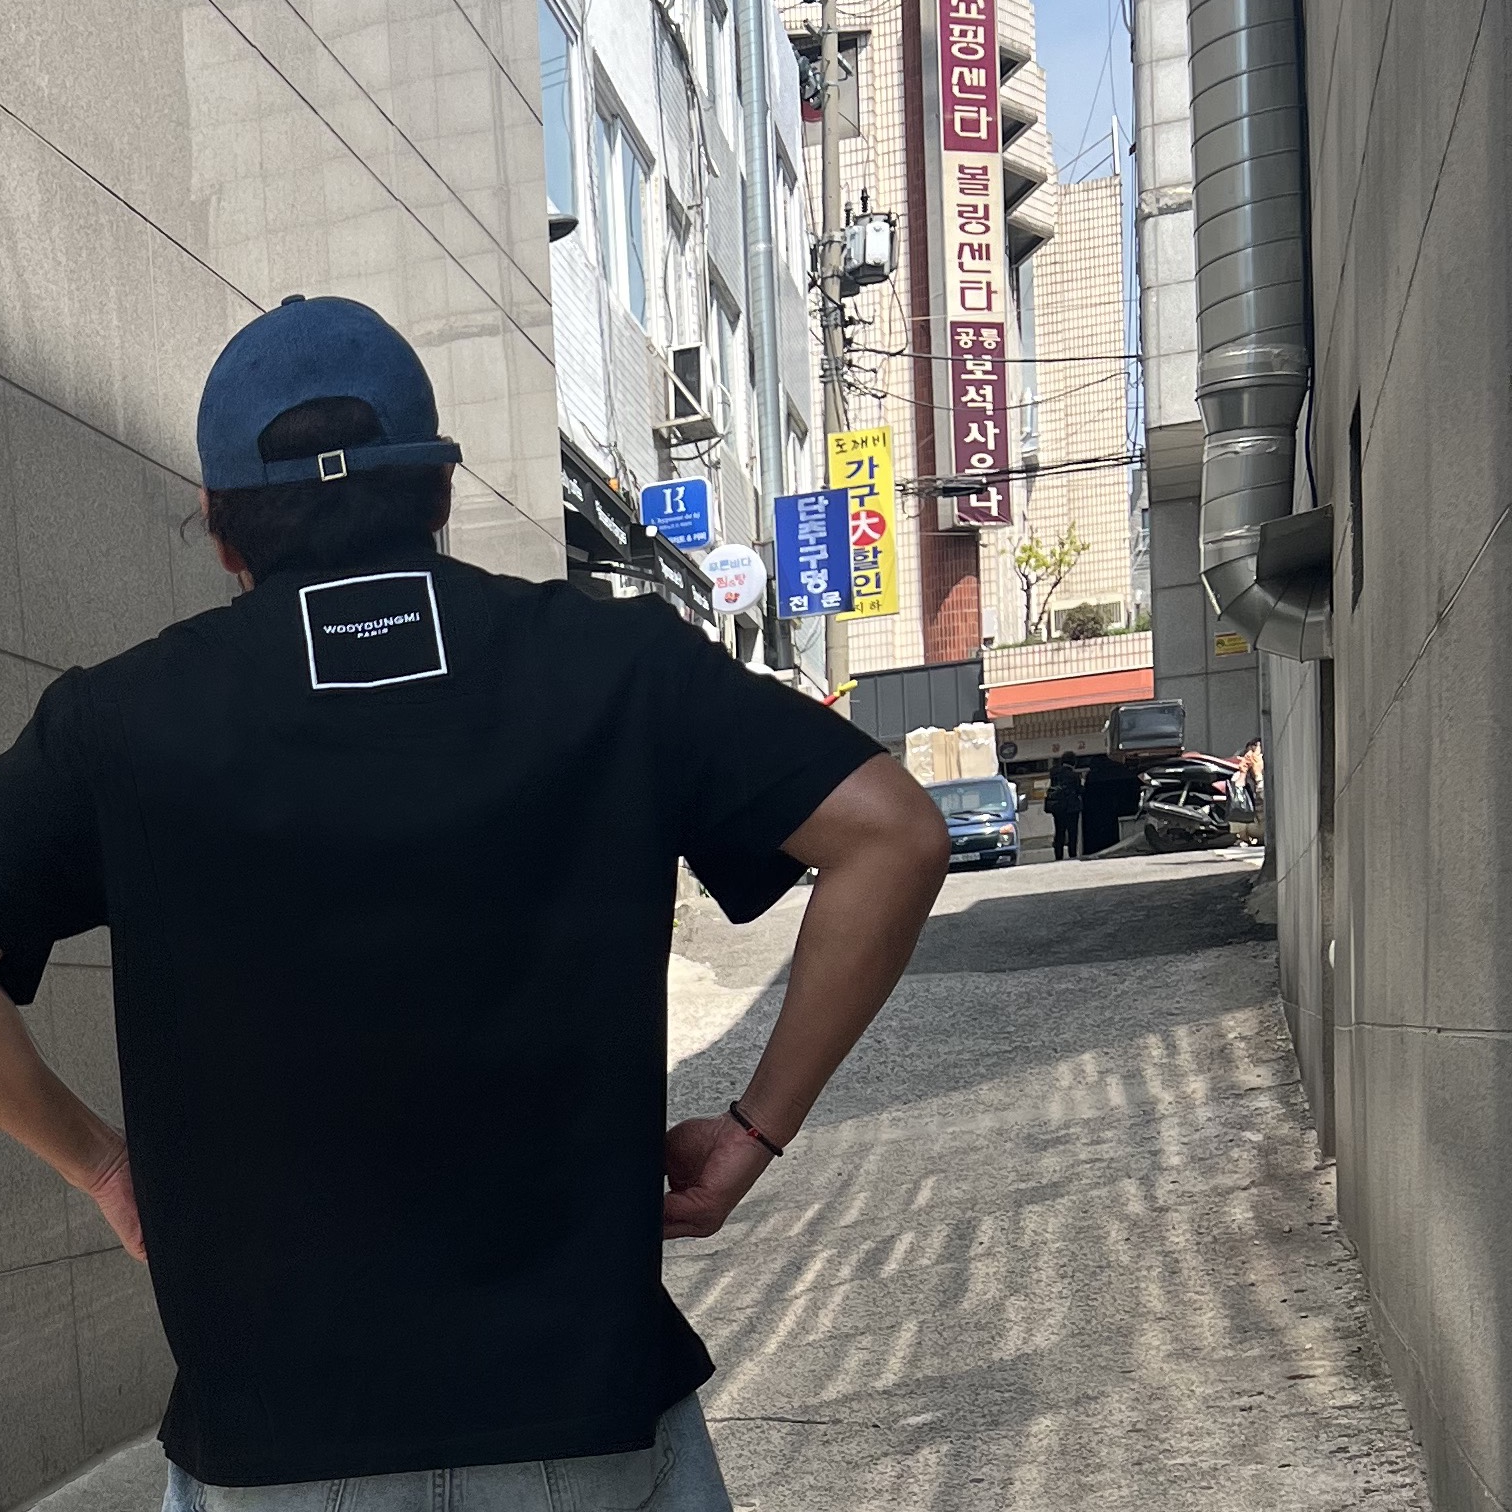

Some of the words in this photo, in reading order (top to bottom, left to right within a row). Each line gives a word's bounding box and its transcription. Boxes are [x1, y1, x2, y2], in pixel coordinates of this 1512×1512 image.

[956, 163, 998, 312] 볼링센타
[954, 327, 1001, 350] 공릉
[961, 353, 1003, 517] 보석사우나
[797, 495, 829, 595] 단추구멍
[323, 612, 421, 634] WOOYOUNGMI
[357, 628, 389, 639] PARIS
